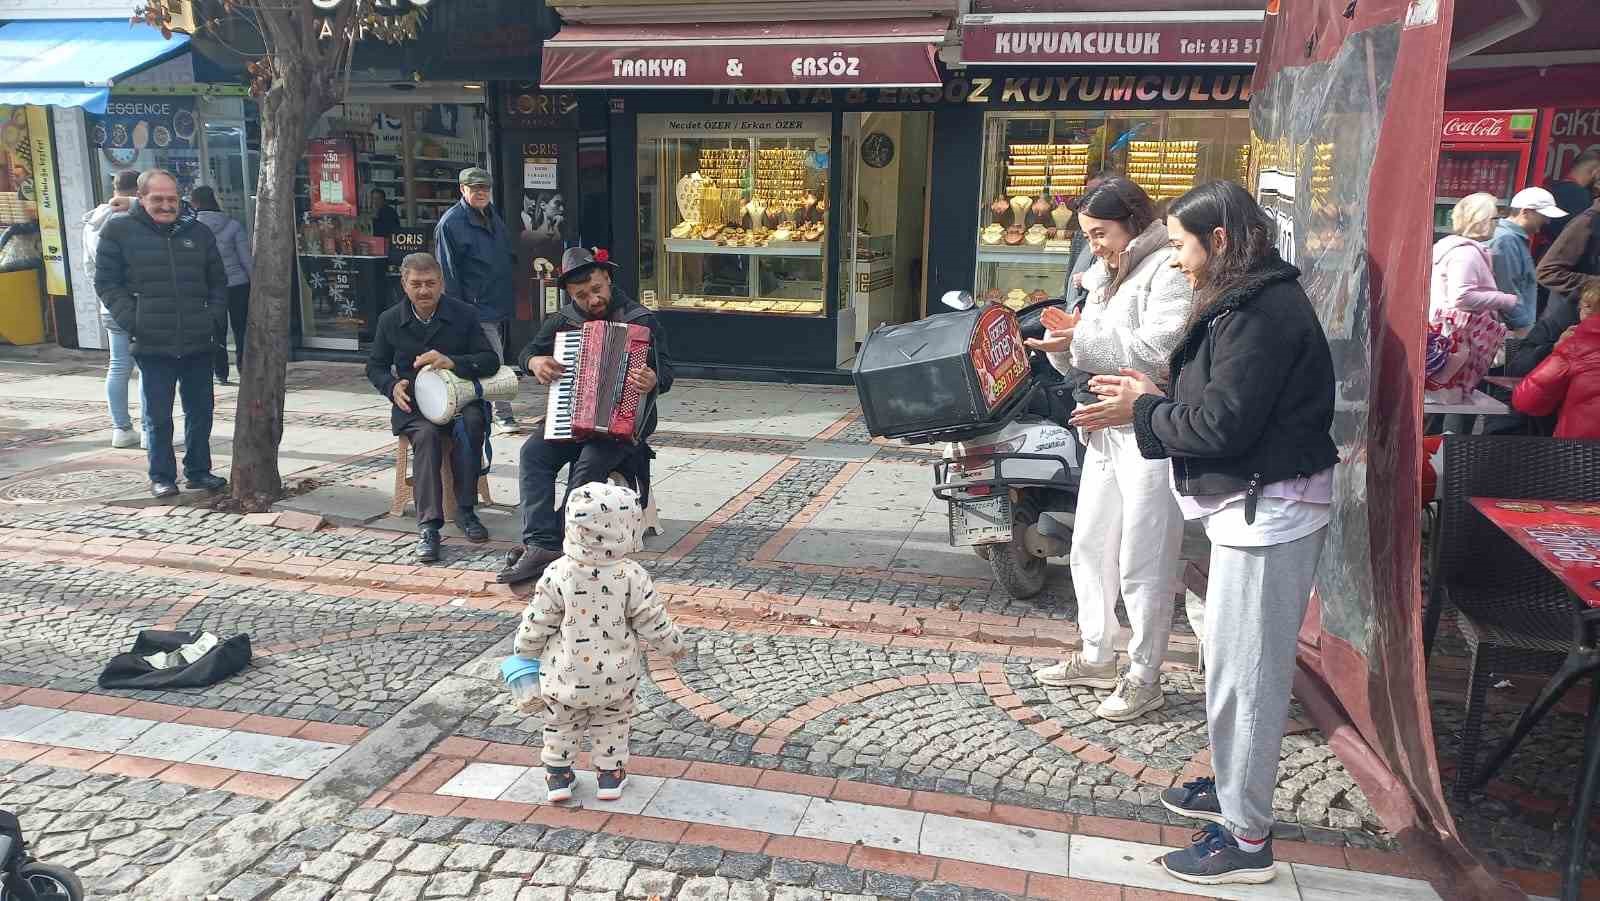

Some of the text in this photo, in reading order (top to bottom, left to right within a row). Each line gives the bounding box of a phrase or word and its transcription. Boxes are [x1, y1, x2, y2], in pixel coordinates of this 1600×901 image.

[995, 31, 1160, 54] KUYUMCULUK
[1179, 38, 1205, 55] Tel:
[1209, 38, 1238, 54] 213
[611, 52, 860, 77] TRAKYA & ERSÖZ
[106, 103, 171, 115] ESSENCE
[507, 94, 569, 114] LORIS
[522, 143, 559, 155] LORIS
[391, 233, 424, 245] LORIS
